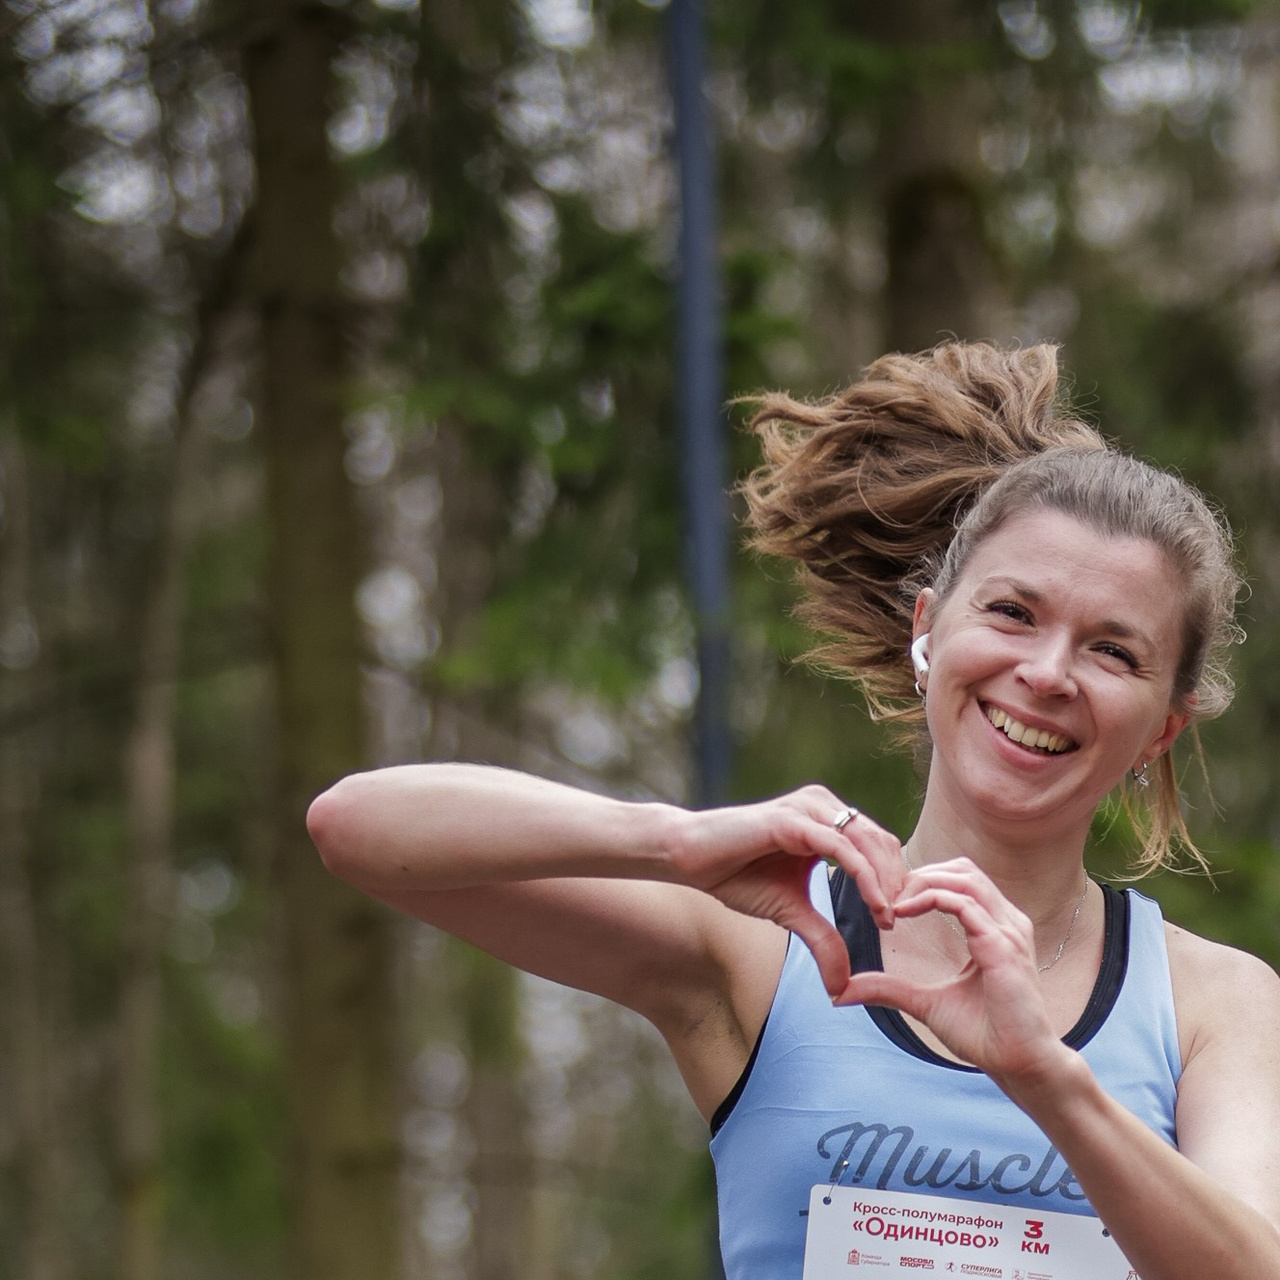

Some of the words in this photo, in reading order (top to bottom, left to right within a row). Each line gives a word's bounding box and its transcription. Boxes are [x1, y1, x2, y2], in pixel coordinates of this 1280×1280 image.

[852, 1201, 1004, 1230] Кросс-полумарафон
[852, 1216, 1000, 1250] «Одинцово»
[1023, 1219, 1044, 1239] 3
[961, 1263, 1003, 1274] СУПЕРЛИГА
